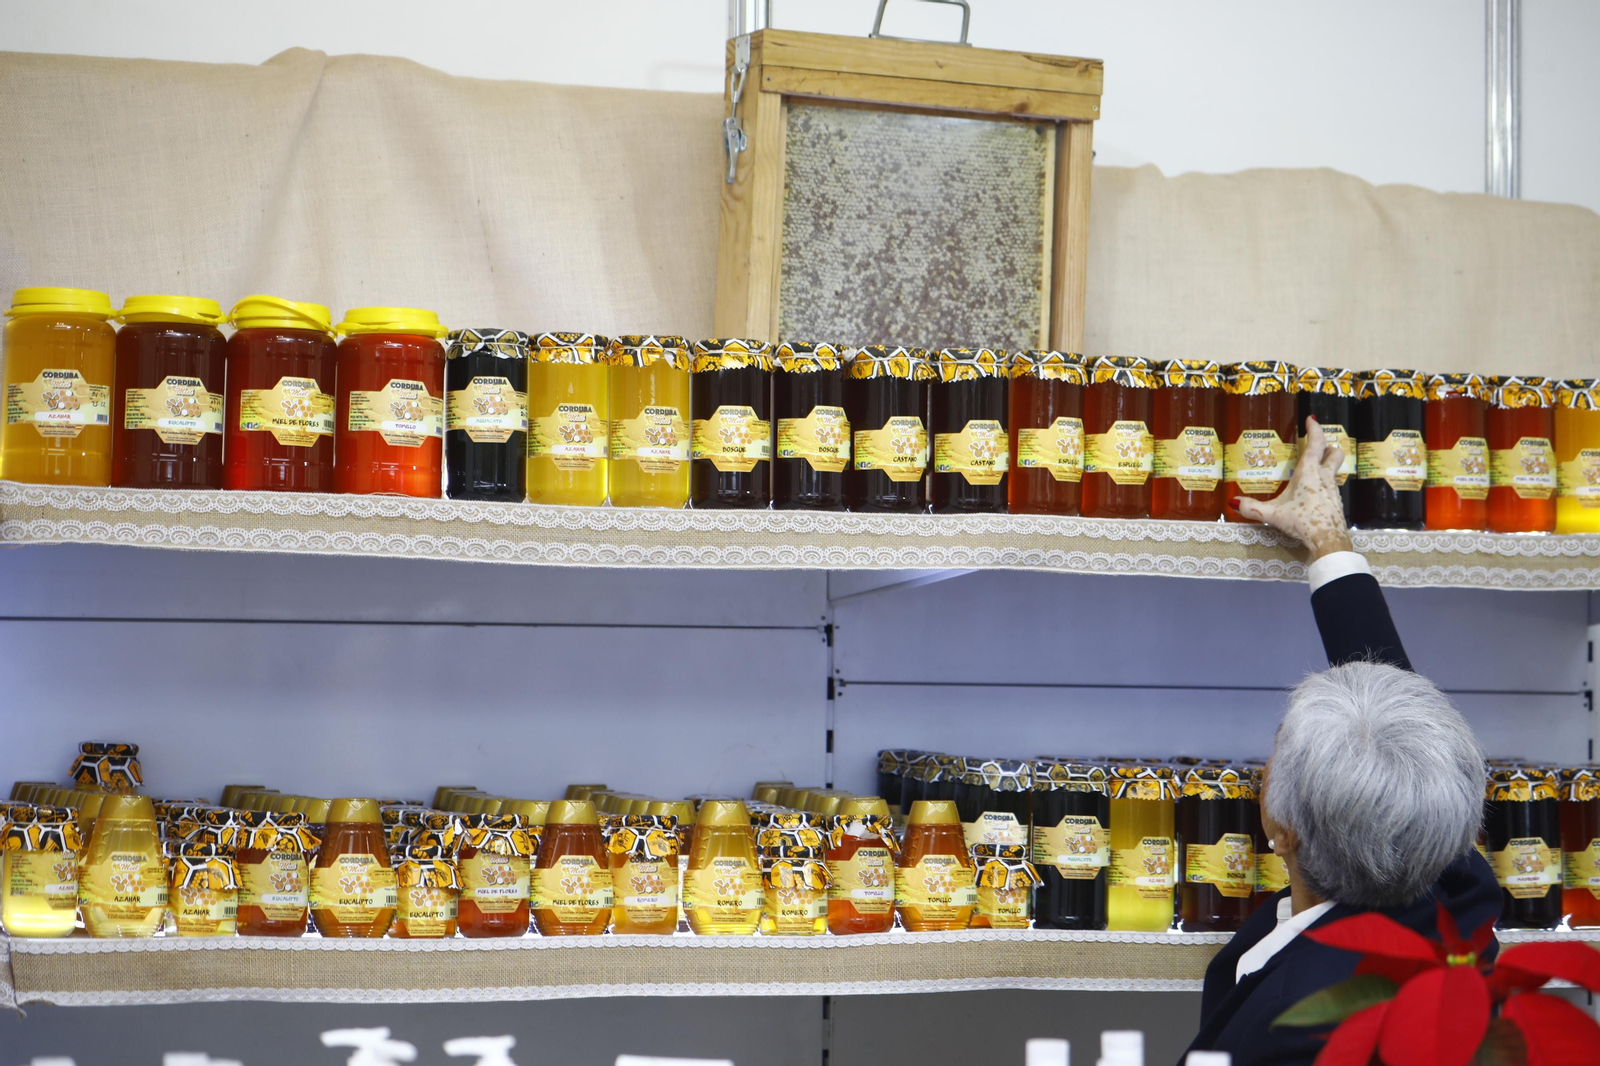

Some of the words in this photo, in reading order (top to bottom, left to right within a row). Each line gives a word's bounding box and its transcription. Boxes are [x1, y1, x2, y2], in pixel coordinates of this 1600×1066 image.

[167, 379, 201, 387] CORDUBA
[282, 380, 315, 389] CORDUBA
[391, 381, 423, 390] CORDUBA
[290, 389, 309, 397] Miel
[815, 409, 844, 417] CORDUBA
[120, 863, 139, 871] Miel
[348, 865, 367, 873] Miel
[569, 866, 587, 874] Miel
[722, 867, 740, 875] Miel
